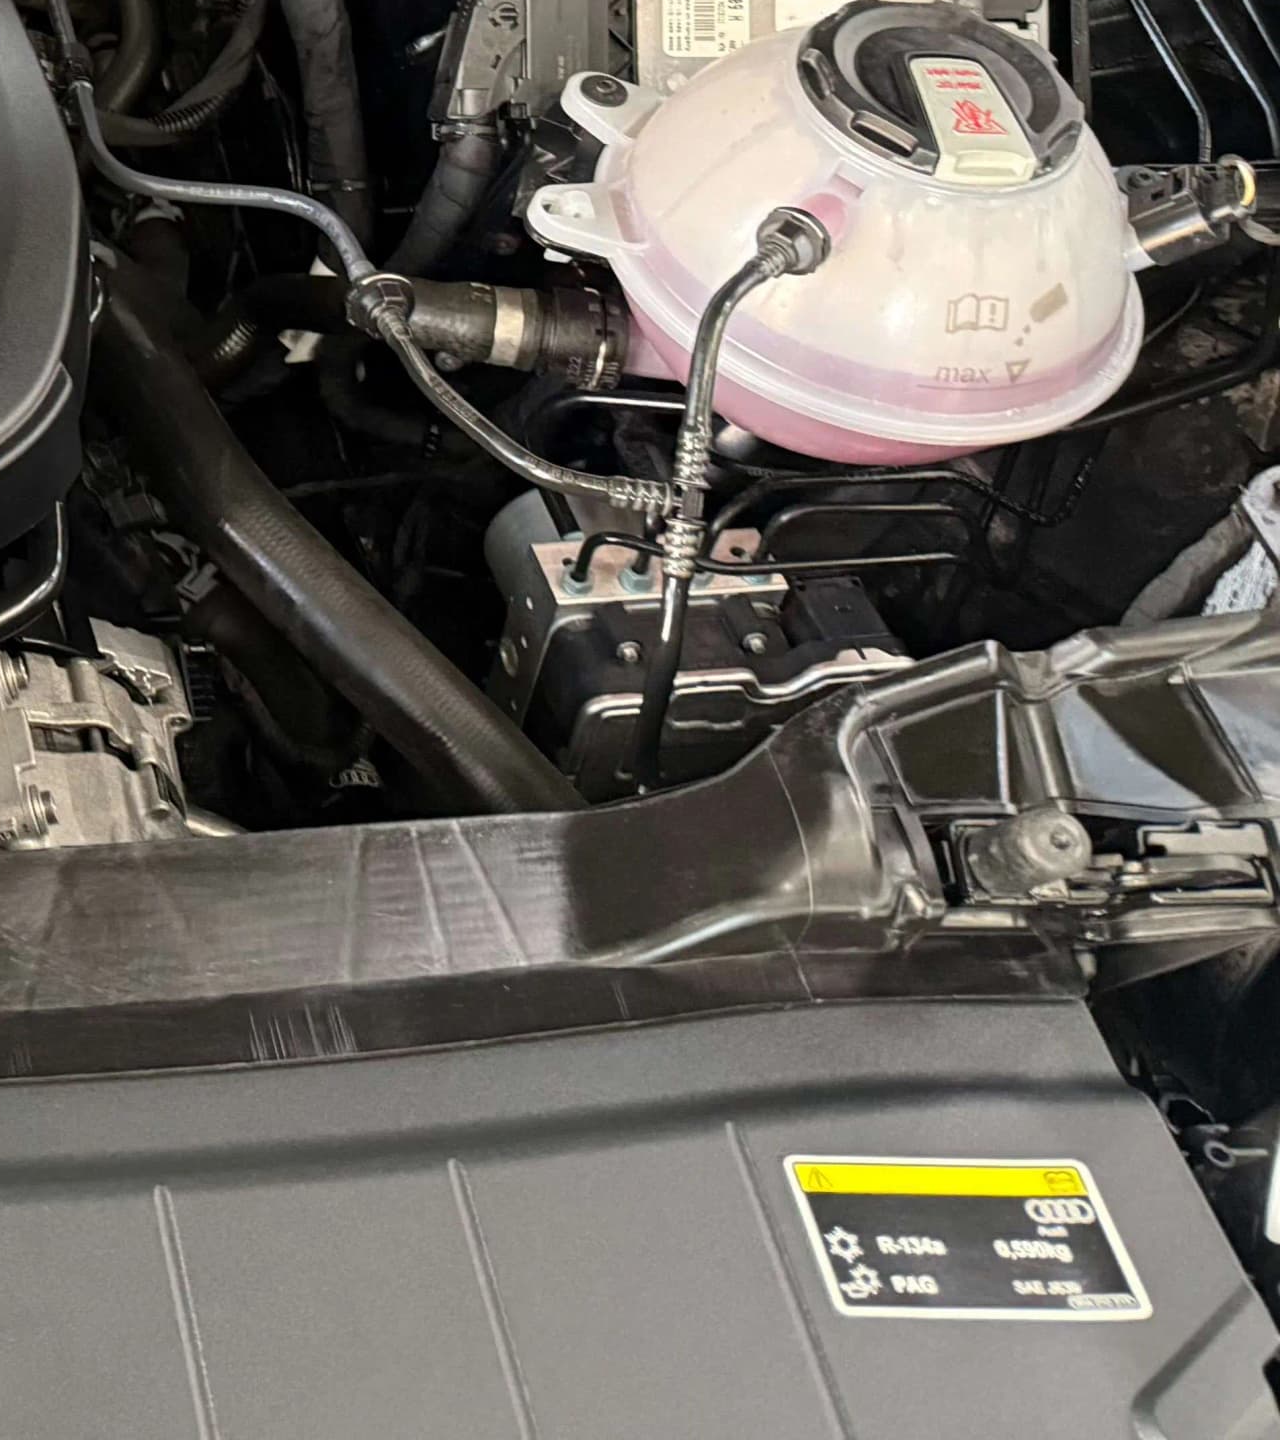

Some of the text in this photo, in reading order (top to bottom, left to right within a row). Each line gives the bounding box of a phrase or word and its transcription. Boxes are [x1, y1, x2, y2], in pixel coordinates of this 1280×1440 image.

[935, 366, 991, 383] max
[875, 1235, 948, 1256] R-134a
[890, 1275, 940, 1295] PAG
